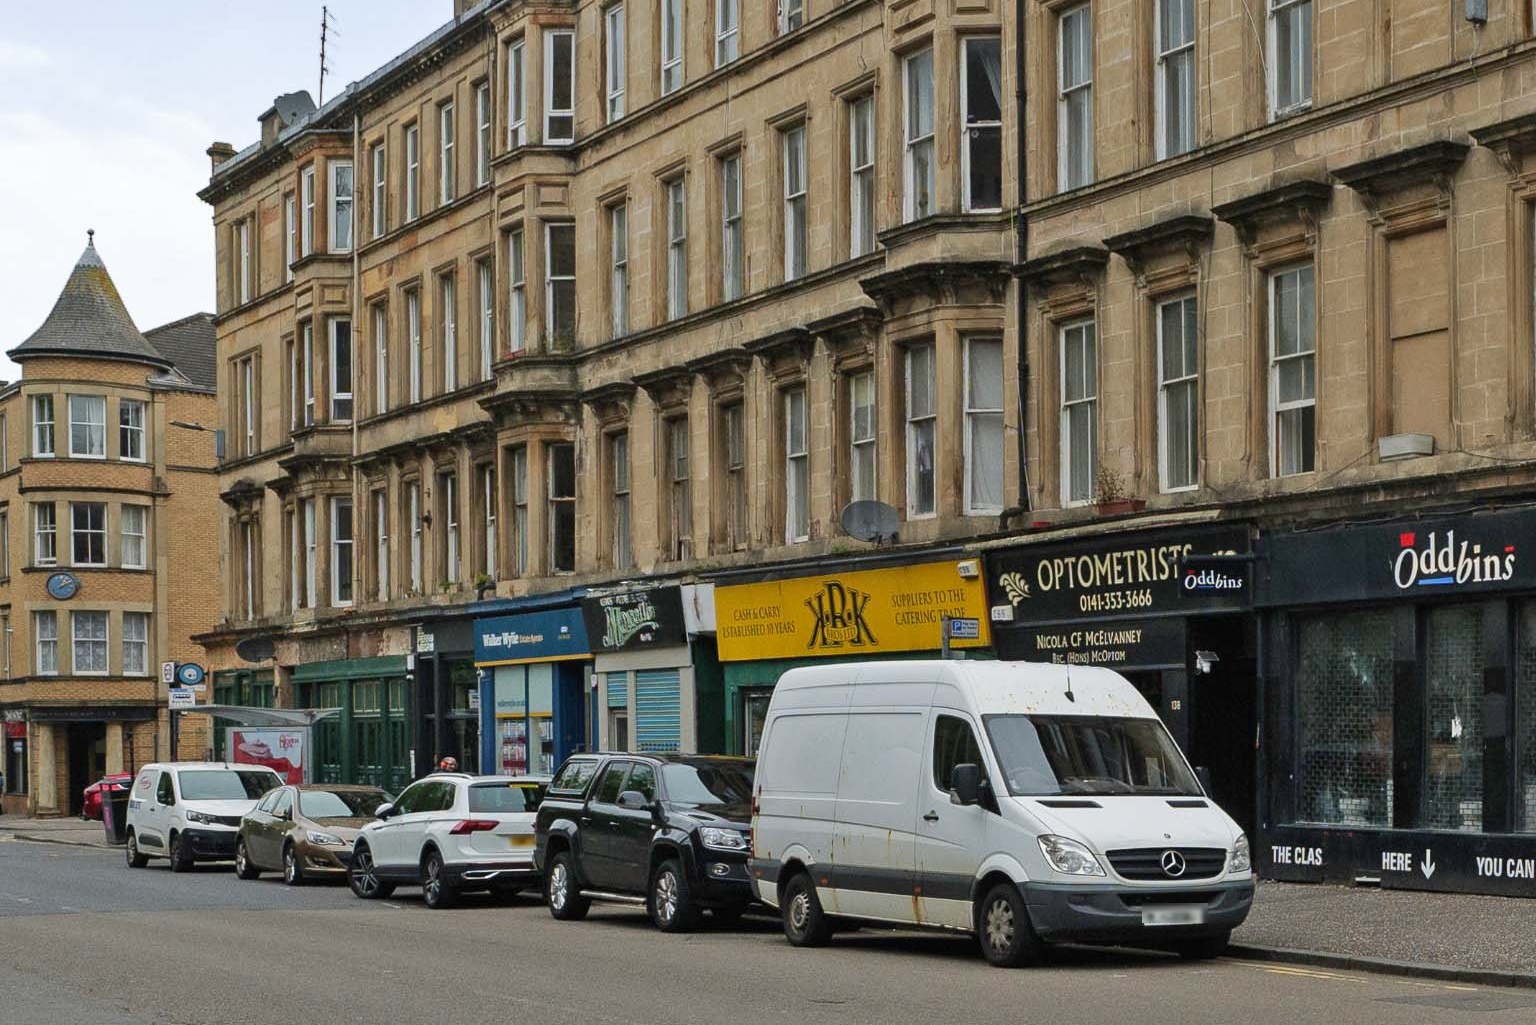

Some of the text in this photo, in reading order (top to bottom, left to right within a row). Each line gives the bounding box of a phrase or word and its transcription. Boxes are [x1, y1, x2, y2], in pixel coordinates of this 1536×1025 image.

[1394, 529, 1516, 589] Oddbins
[1184, 569, 1243, 590] Oddbins
[891, 588, 966, 607] SUPPLIERS TO THE
[1079, 588, 1153, 612] 0141-353-3666
[758, 605, 781, 620] CARRY
[895, 609, 937, 625] CATERING
[722, 624, 766, 639] ESTABLISHED
[774, 621, 796, 636] YEARS
[1070, 632, 1082, 647] CF
[1271, 846, 1412, 871] THE CLAS HERE
[1476, 857, 1503, 877] YOU
[1506, 859, 1535, 879] CAN
